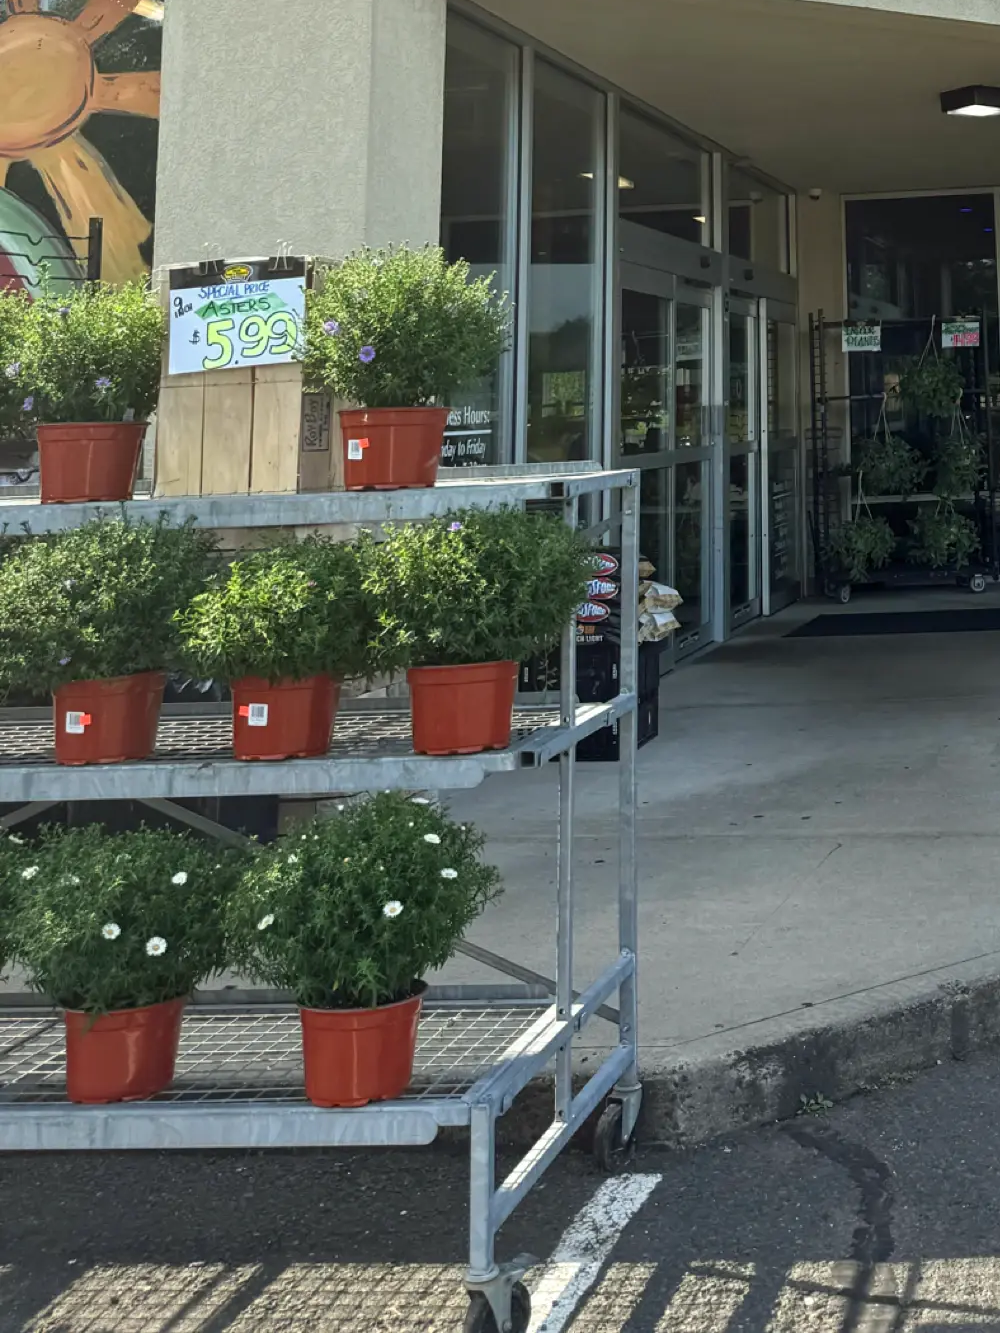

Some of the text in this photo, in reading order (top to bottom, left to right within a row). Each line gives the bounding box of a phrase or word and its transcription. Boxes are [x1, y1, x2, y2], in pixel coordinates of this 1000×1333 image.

[198, 281, 270, 300] SPECIAL PRICE
[173, 296, 183, 312] 9
[202, 297, 271, 317] ASTERS
[464, 405, 490, 425] Hours:
[457, 441, 466, 456] to
[465, 437, 487, 459] Friday
